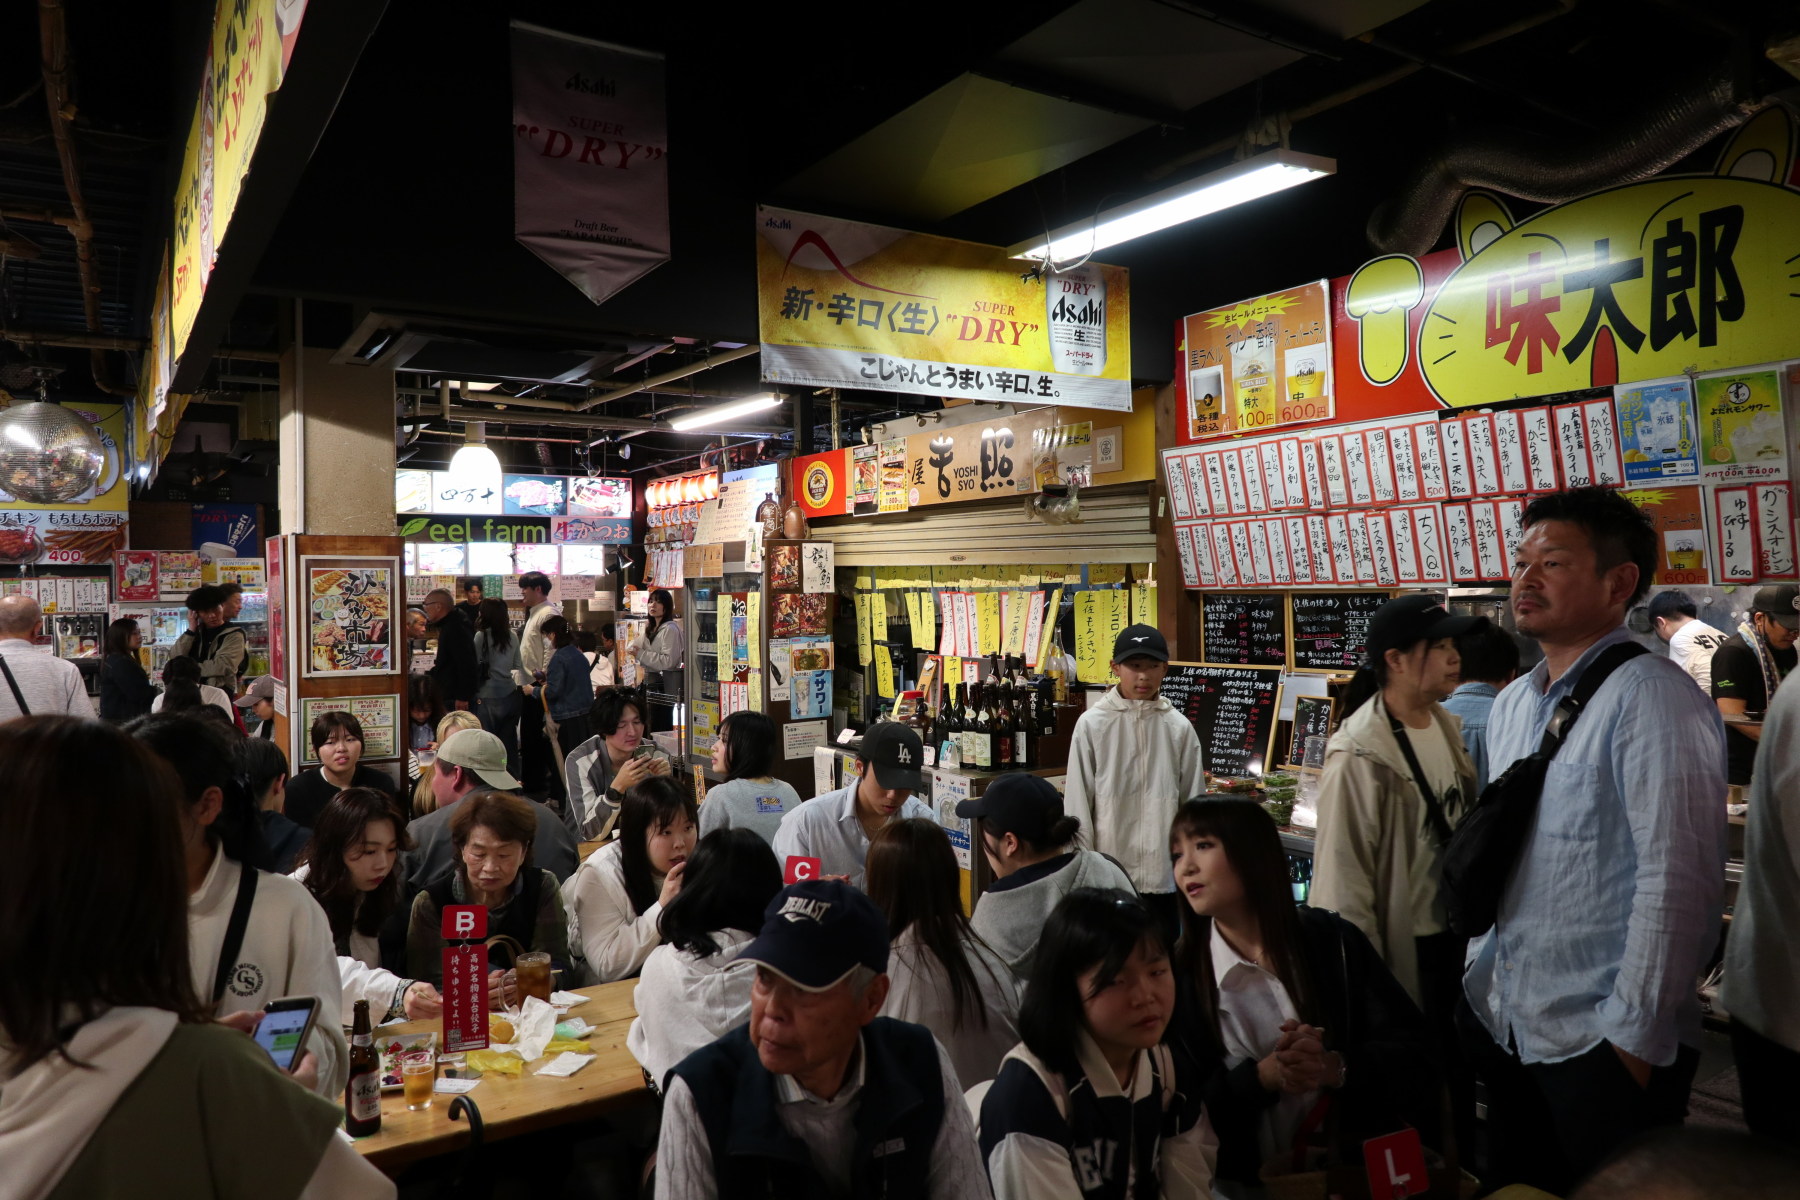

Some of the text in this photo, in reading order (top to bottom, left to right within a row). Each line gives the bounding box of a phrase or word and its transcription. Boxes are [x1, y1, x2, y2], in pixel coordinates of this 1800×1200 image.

[565, 72, 616, 97] Asahi
[569, 116, 624, 136] SUPER
[575, 219, 618, 233] Draft Beer
[766, 217, 791, 231] Asahi
[1485, 204, 1745, 375] 味太郎
[973, 300, 1015, 316] SUPER
[1052, 295, 1102, 326] Asahi
[1224, 306, 1276, 323] 生ビールメニュー
[1074, 330, 1085, 342] 生
[860, 356, 1060, 398] こじゃんとうまい辛口、生。
[1297, 367, 1315, 378] Asahi
[1244, 398, 1258, 409] 特大
[1293, 392, 1304, 402] 中
[1198, 412, 1219, 422] 各種
[1282, 404, 1326, 420] 600円
[1710, 404, 1770, 415] よだれモンサワー
[1657, 415, 1674, 425] 氷結
[1197, 424, 1219, 433] 税込
[1537, 417, 1547, 442] たこ
[1601, 406, 1612, 450] メヒカリ
[1068, 434, 1090, 445] 生ビール
[1591, 418, 1604, 466] からあげ
[1682, 441, 1686, 449] 2
[1374, 432, 1386, 464] 四万十
[1447, 425, 1462, 476] じゃこ天
[1499, 427, 1512, 476] からあげ
[1528, 430, 1542, 478] からあげ
[1562, 423, 1576, 473] カキフライ
[953, 465, 978, 478] YOSHI
[958, 479, 975, 491] SYO
[1512, 481, 1525, 489] 600
[1539, 480, 1551, 488] 600
[1570, 475, 1590, 487] 800
[441, 488, 495, 504] 四万十
[1427, 487, 1444, 496] 500
[1452, 486, 1466, 494] 500
[1288, 496, 1304, 504] 1300
[48, 512, 124, 525] もちもちポテト
[429, 517, 546, 543] eel farm
[1372, 520, 1390, 576] ナスのタタキ
[1395, 530, 1406, 564] トマト
[1450, 525, 1460, 560] タタキ
[1476, 519, 1491, 565] からあげ
[49, 550, 81, 562] 400
[1276, 574, 1291, 582] 400
[1460, 566, 1473, 575] 800
[1487, 568, 1501, 577] 600
[1665, 572, 1706, 584] 600円
[1731, 565, 1751, 576] 600
[1243, 575, 1255, 583] 500
[335, 572, 377, 668] ひろめ市場
[1084, 593, 1096, 668] 土佐もろきゅう
[1182, 667, 1259, 680] 土佐の名物料理あります
[898, 743, 911, 764] LA
[795, 862, 811, 879] C
[456, 911, 475, 931] B
[469, 953, 480, 1033] 高知名物屋台餃子
[1384, 1149, 1411, 1185] L
